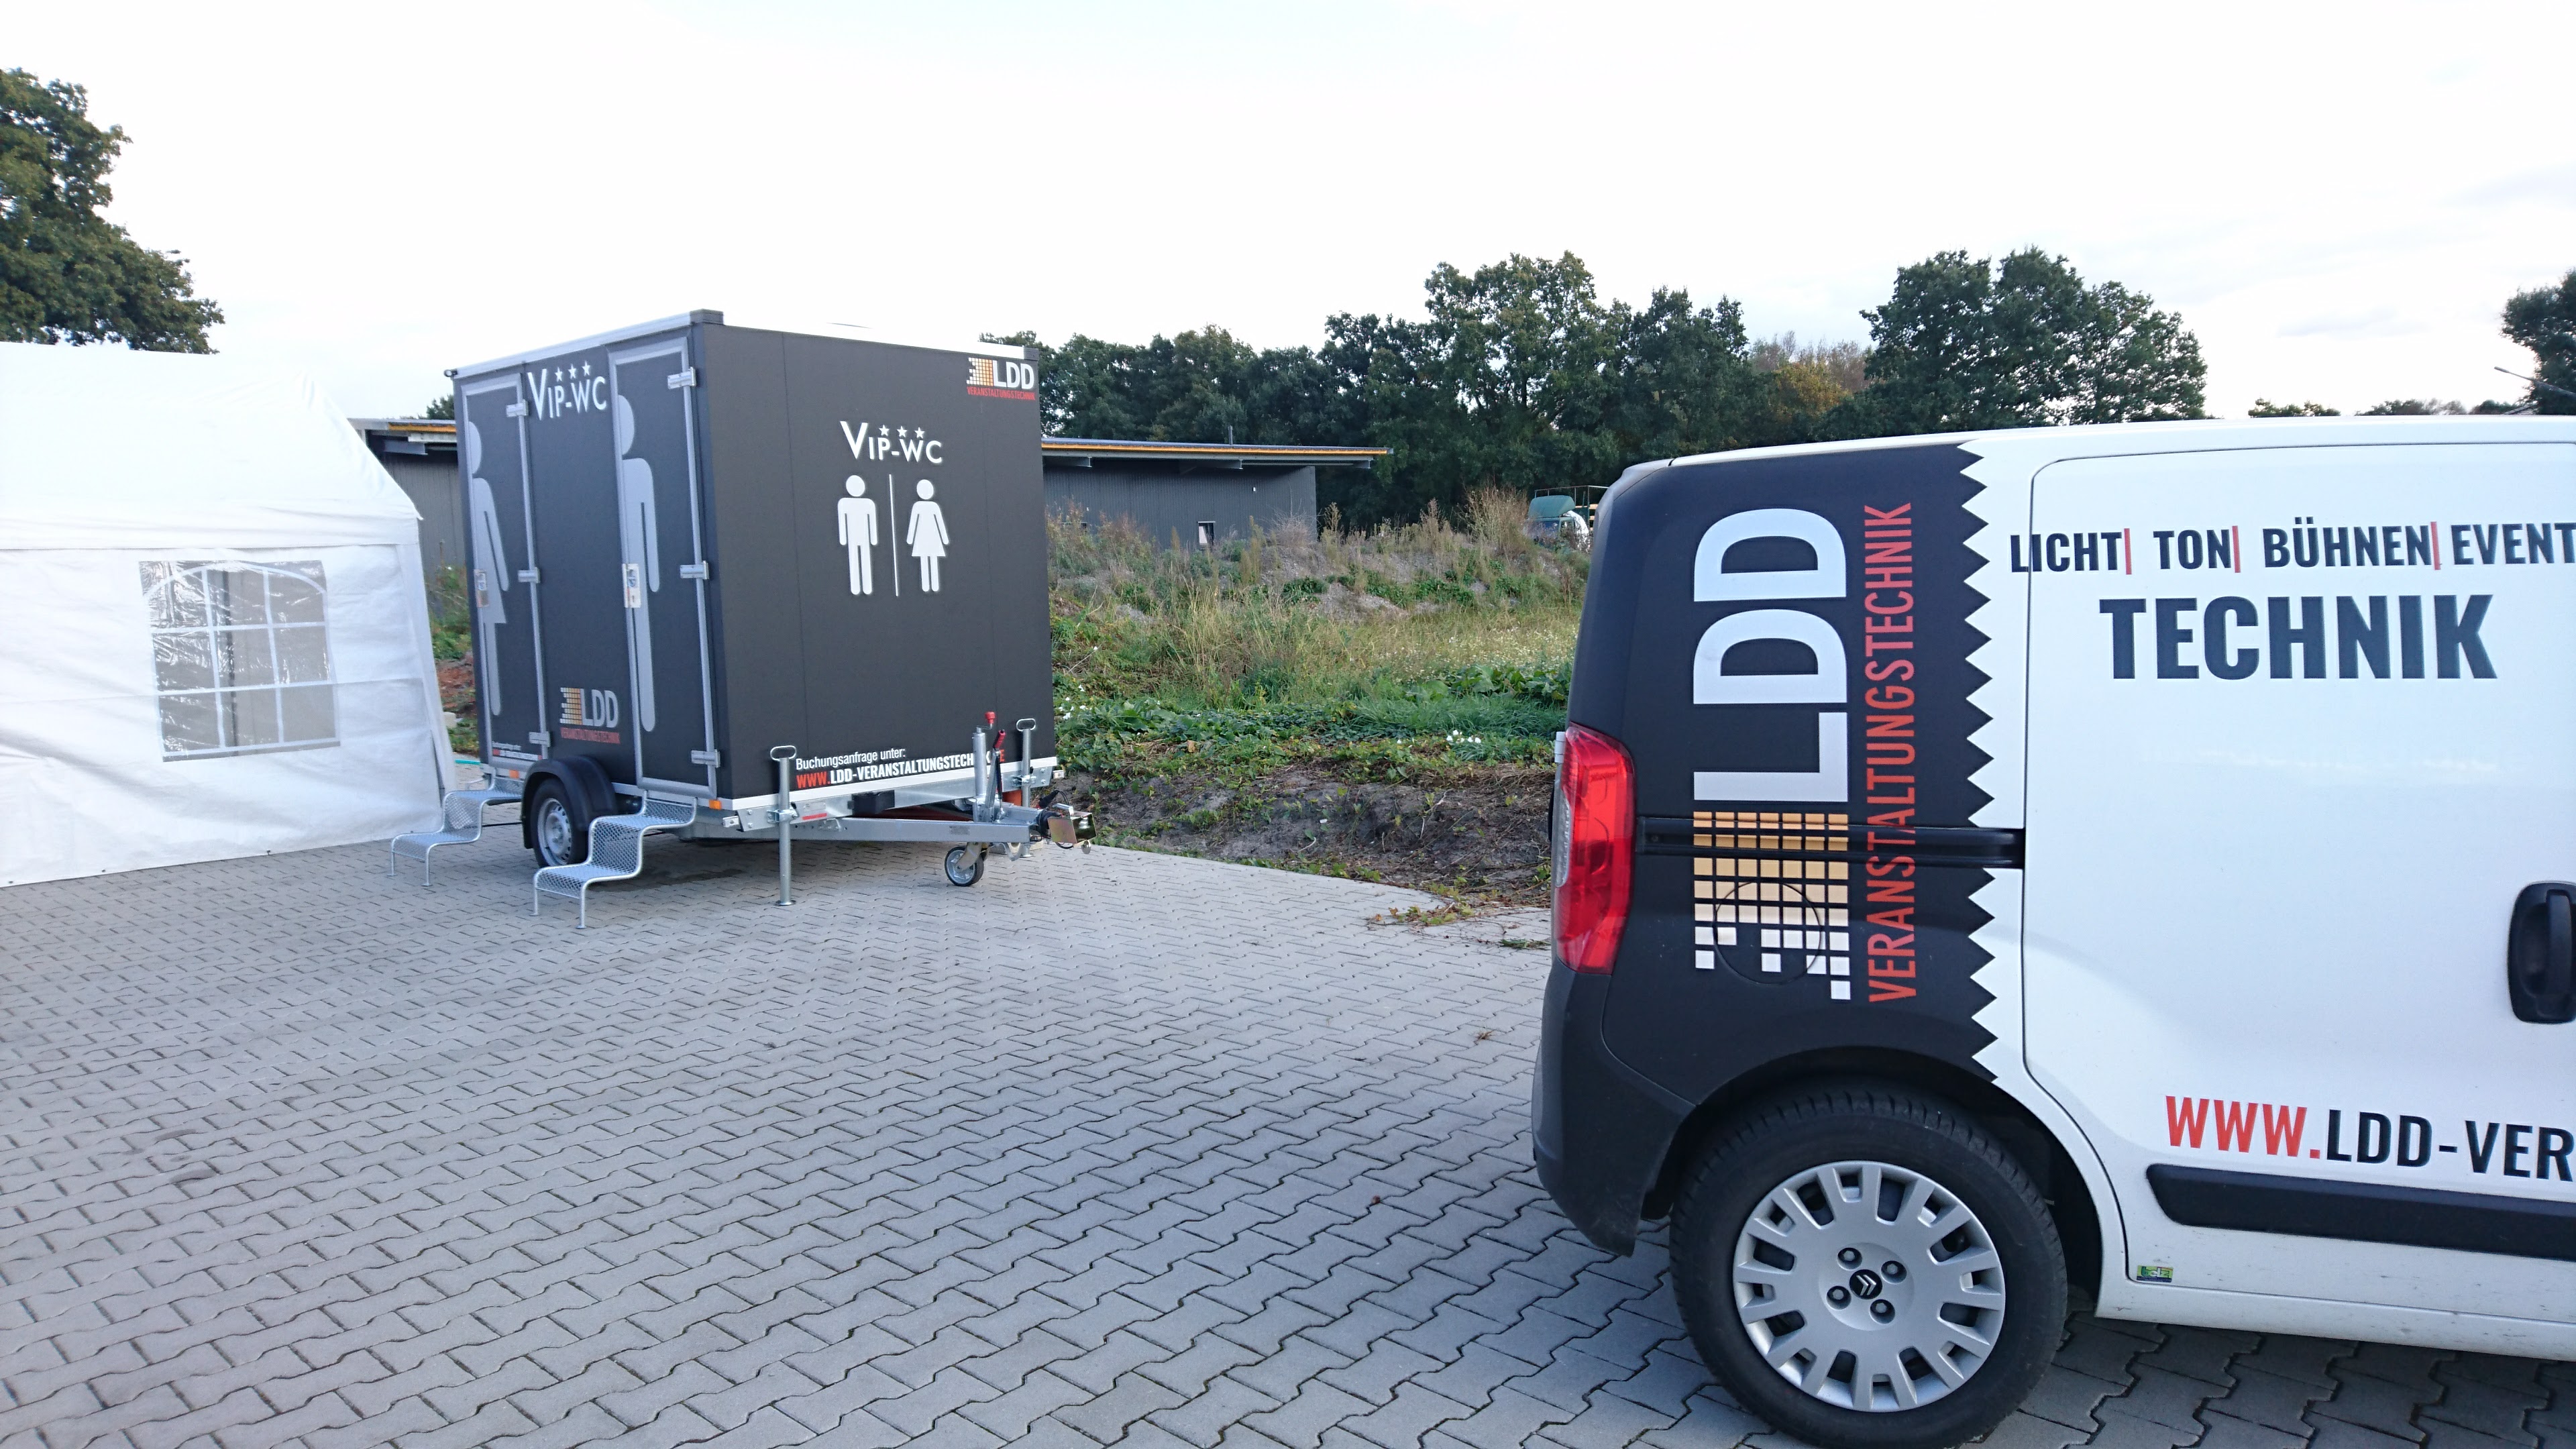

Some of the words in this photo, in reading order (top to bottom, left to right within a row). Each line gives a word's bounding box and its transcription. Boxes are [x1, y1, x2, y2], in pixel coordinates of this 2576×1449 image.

[993, 360, 1034, 389] LDD
[1693, 508, 1848, 803] LDD
[2099, 594, 2498, 680] TECHNIK
[580, 688, 619, 729] LDD
[796, 751, 877, 770] Buchungsanfrage
[880, 748, 906, 761] unter:
[1864, 502, 1917, 1002] VERANSTALTUNGSTECHNIK
